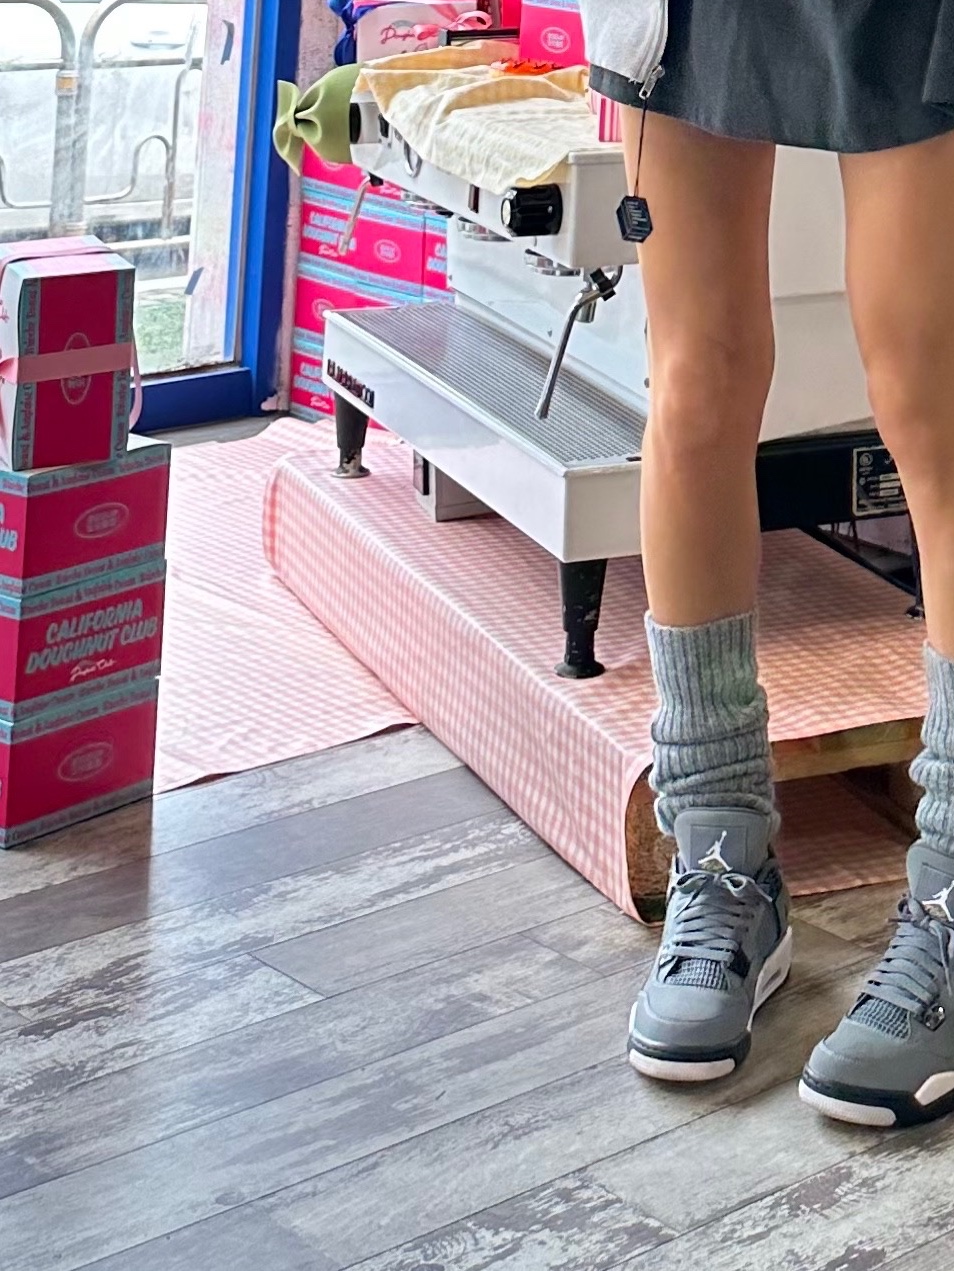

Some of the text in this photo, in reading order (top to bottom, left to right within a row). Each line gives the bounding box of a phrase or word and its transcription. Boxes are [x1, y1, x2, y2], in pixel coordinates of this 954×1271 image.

[25, 628, 120, 675] DOUGHNUT
[120, 617, 158, 645] CLUB
[46, 598, 144, 644] CALIFORNIA
